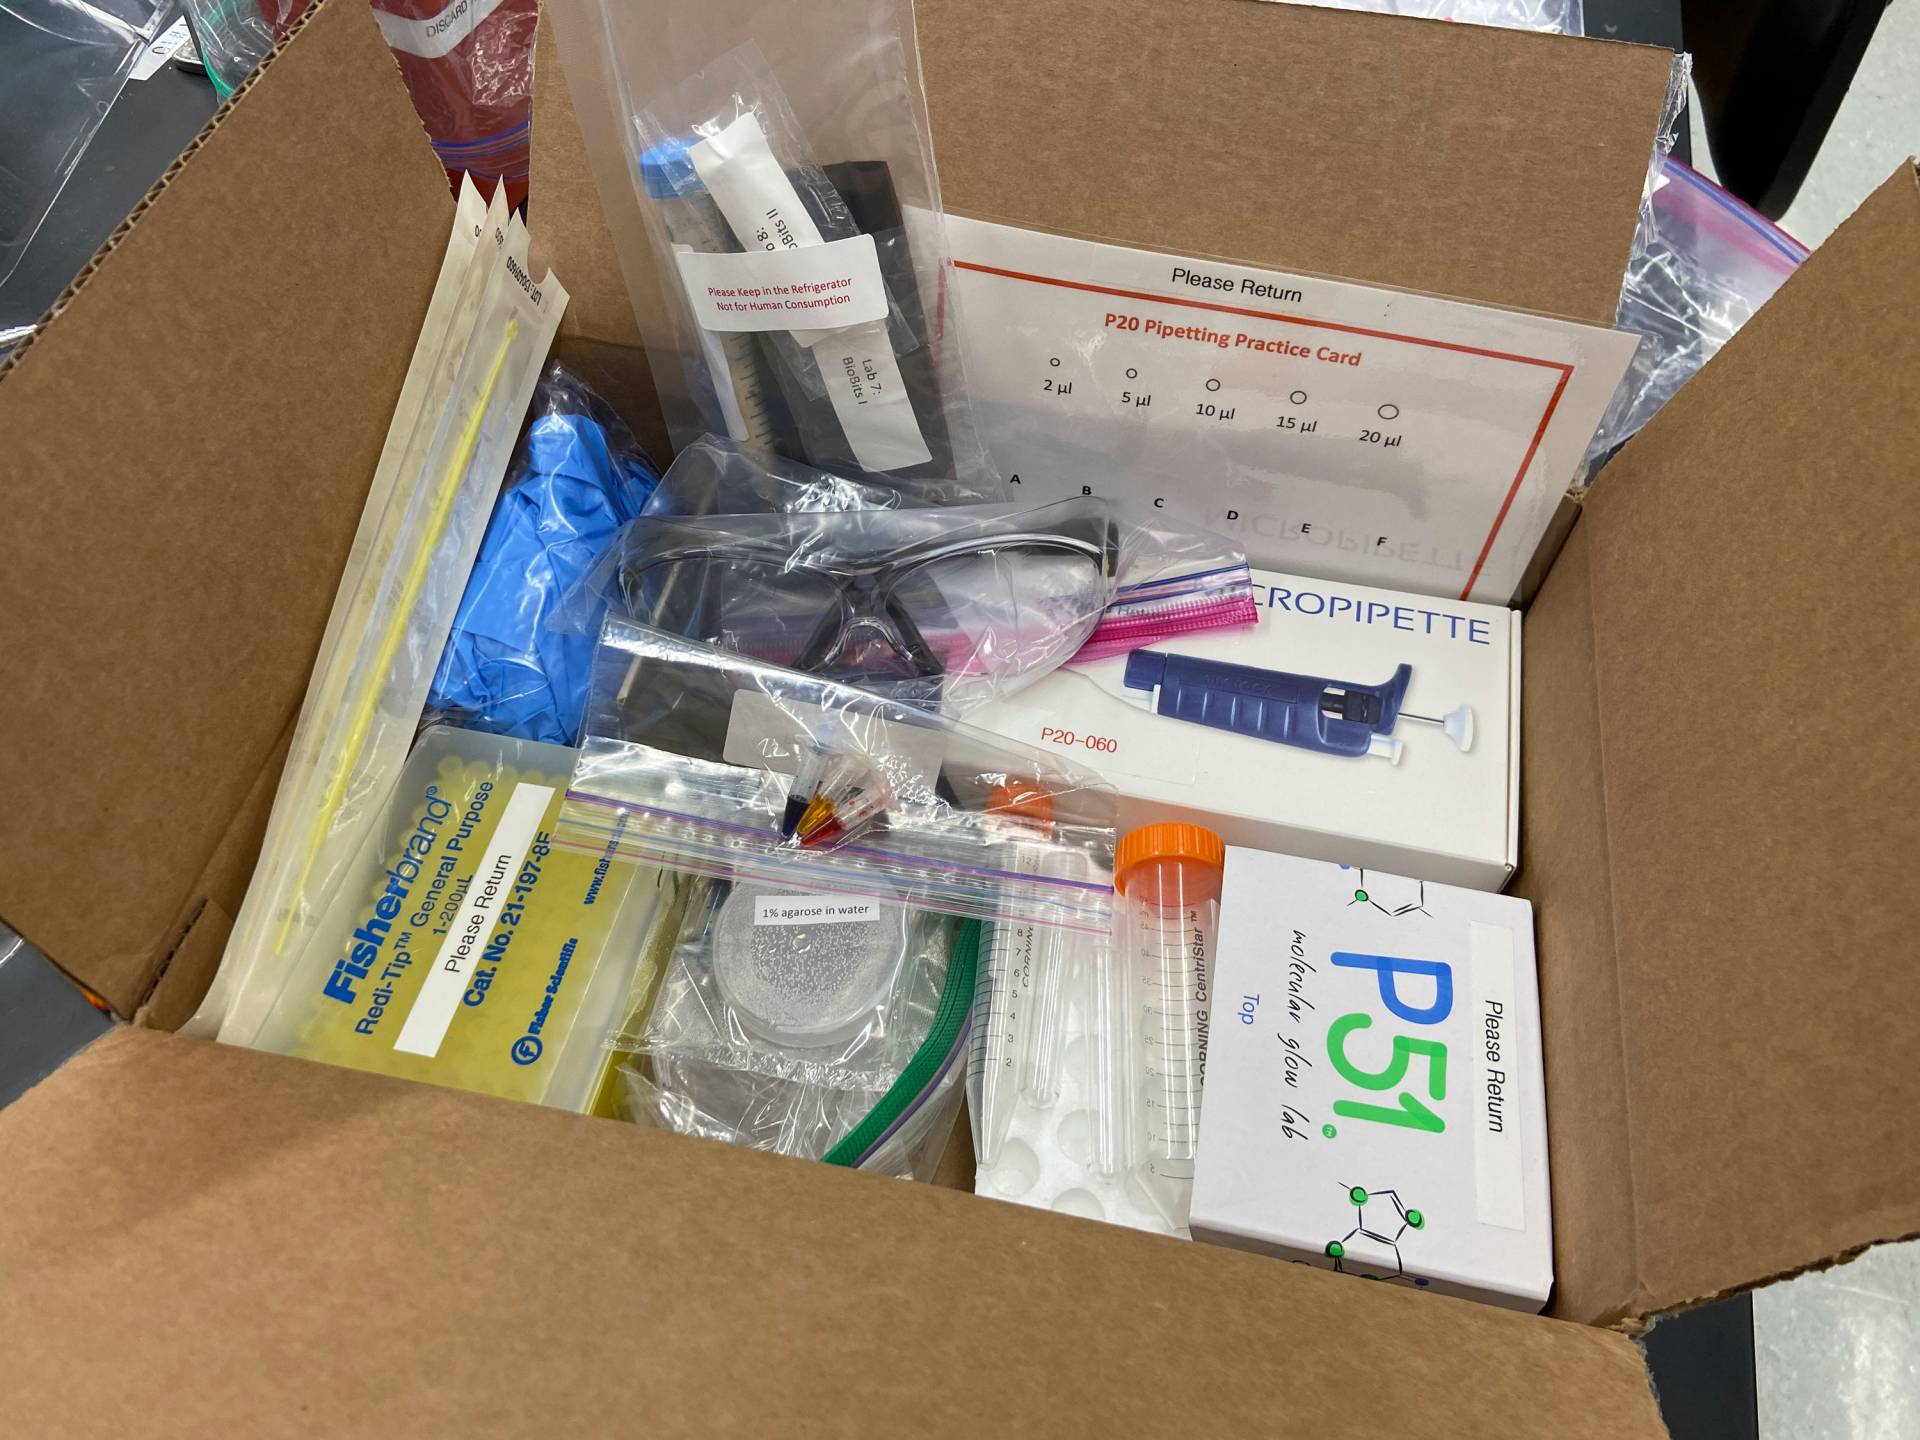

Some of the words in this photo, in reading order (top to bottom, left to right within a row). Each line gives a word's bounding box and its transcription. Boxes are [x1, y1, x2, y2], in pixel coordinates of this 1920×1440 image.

[426, 0, 468, 38] DISCARD
[708, 286, 737, 298] Please
[737, 285, 761, 299] Keep
[763, 286, 772, 296] in
[773, 285, 790, 296] the
[791, 277, 852, 295] Refrigerator
[1171, 267, 1234, 292] Please
[1240, 279, 1303, 303] Return
[716, 301, 733, 312] Not
[734, 300, 748, 312] for
[750, 299, 784, 311] Human
[785, 293, 851, 311] Consumption
[1104, 313, 1140, 332] P20
[1144, 319, 1231, 348] Pipetting
[1234, 333, 1311, 359] Practice
[1316, 346, 1362, 367] Card
[842, 356, 864, 399] BioBits
[862, 359, 878, 381] Lab
[870, 382, 882, 396] 7:
[1043, 380, 1053, 392] 2
[1121, 391, 1132, 404] 5
[1195, 403, 1216, 418] 10
[1276, 416, 1297, 430] 15
[1359, 429, 1382, 444] 20
[1009, 474, 1022, 485] A
[1081, 485, 1093, 496] B
[1153, 497, 1164, 509] C
[1226, 510, 1239, 521] D
[1301, 523, 1312, 534] E
[1377, 536, 1388, 547] F
[1040, 727, 1118, 753] P20-060
[410, 856, 454, 928] General
[446, 781, 494, 854] Purpose
[444, 912, 485, 973] Please
[474, 853, 513, 911] Return
[763, 907, 779, 919] 1%
[781, 905, 823, 919] agarose
[824, 905, 835, 916] in
[836, 904, 870, 917] water
[463, 965, 497, 1007] Cat.
[485, 924, 515, 963] No.
[1286, 929, 1317, 1024] molecular
[529, 996, 550, 1035] Fisher
[543, 937, 579, 995] Scientific
[1241, 993, 1261, 1026] Top
[1007, 1033, 1014, 1044] 3
[1484, 1000, 1501, 1062] Please
[1004, 1057, 1012, 1067] 2
[1277, 1032, 1312, 1089] glow
[1487, 1069, 1506, 1133] Return
[1280, 1103, 1309, 1141] lab
